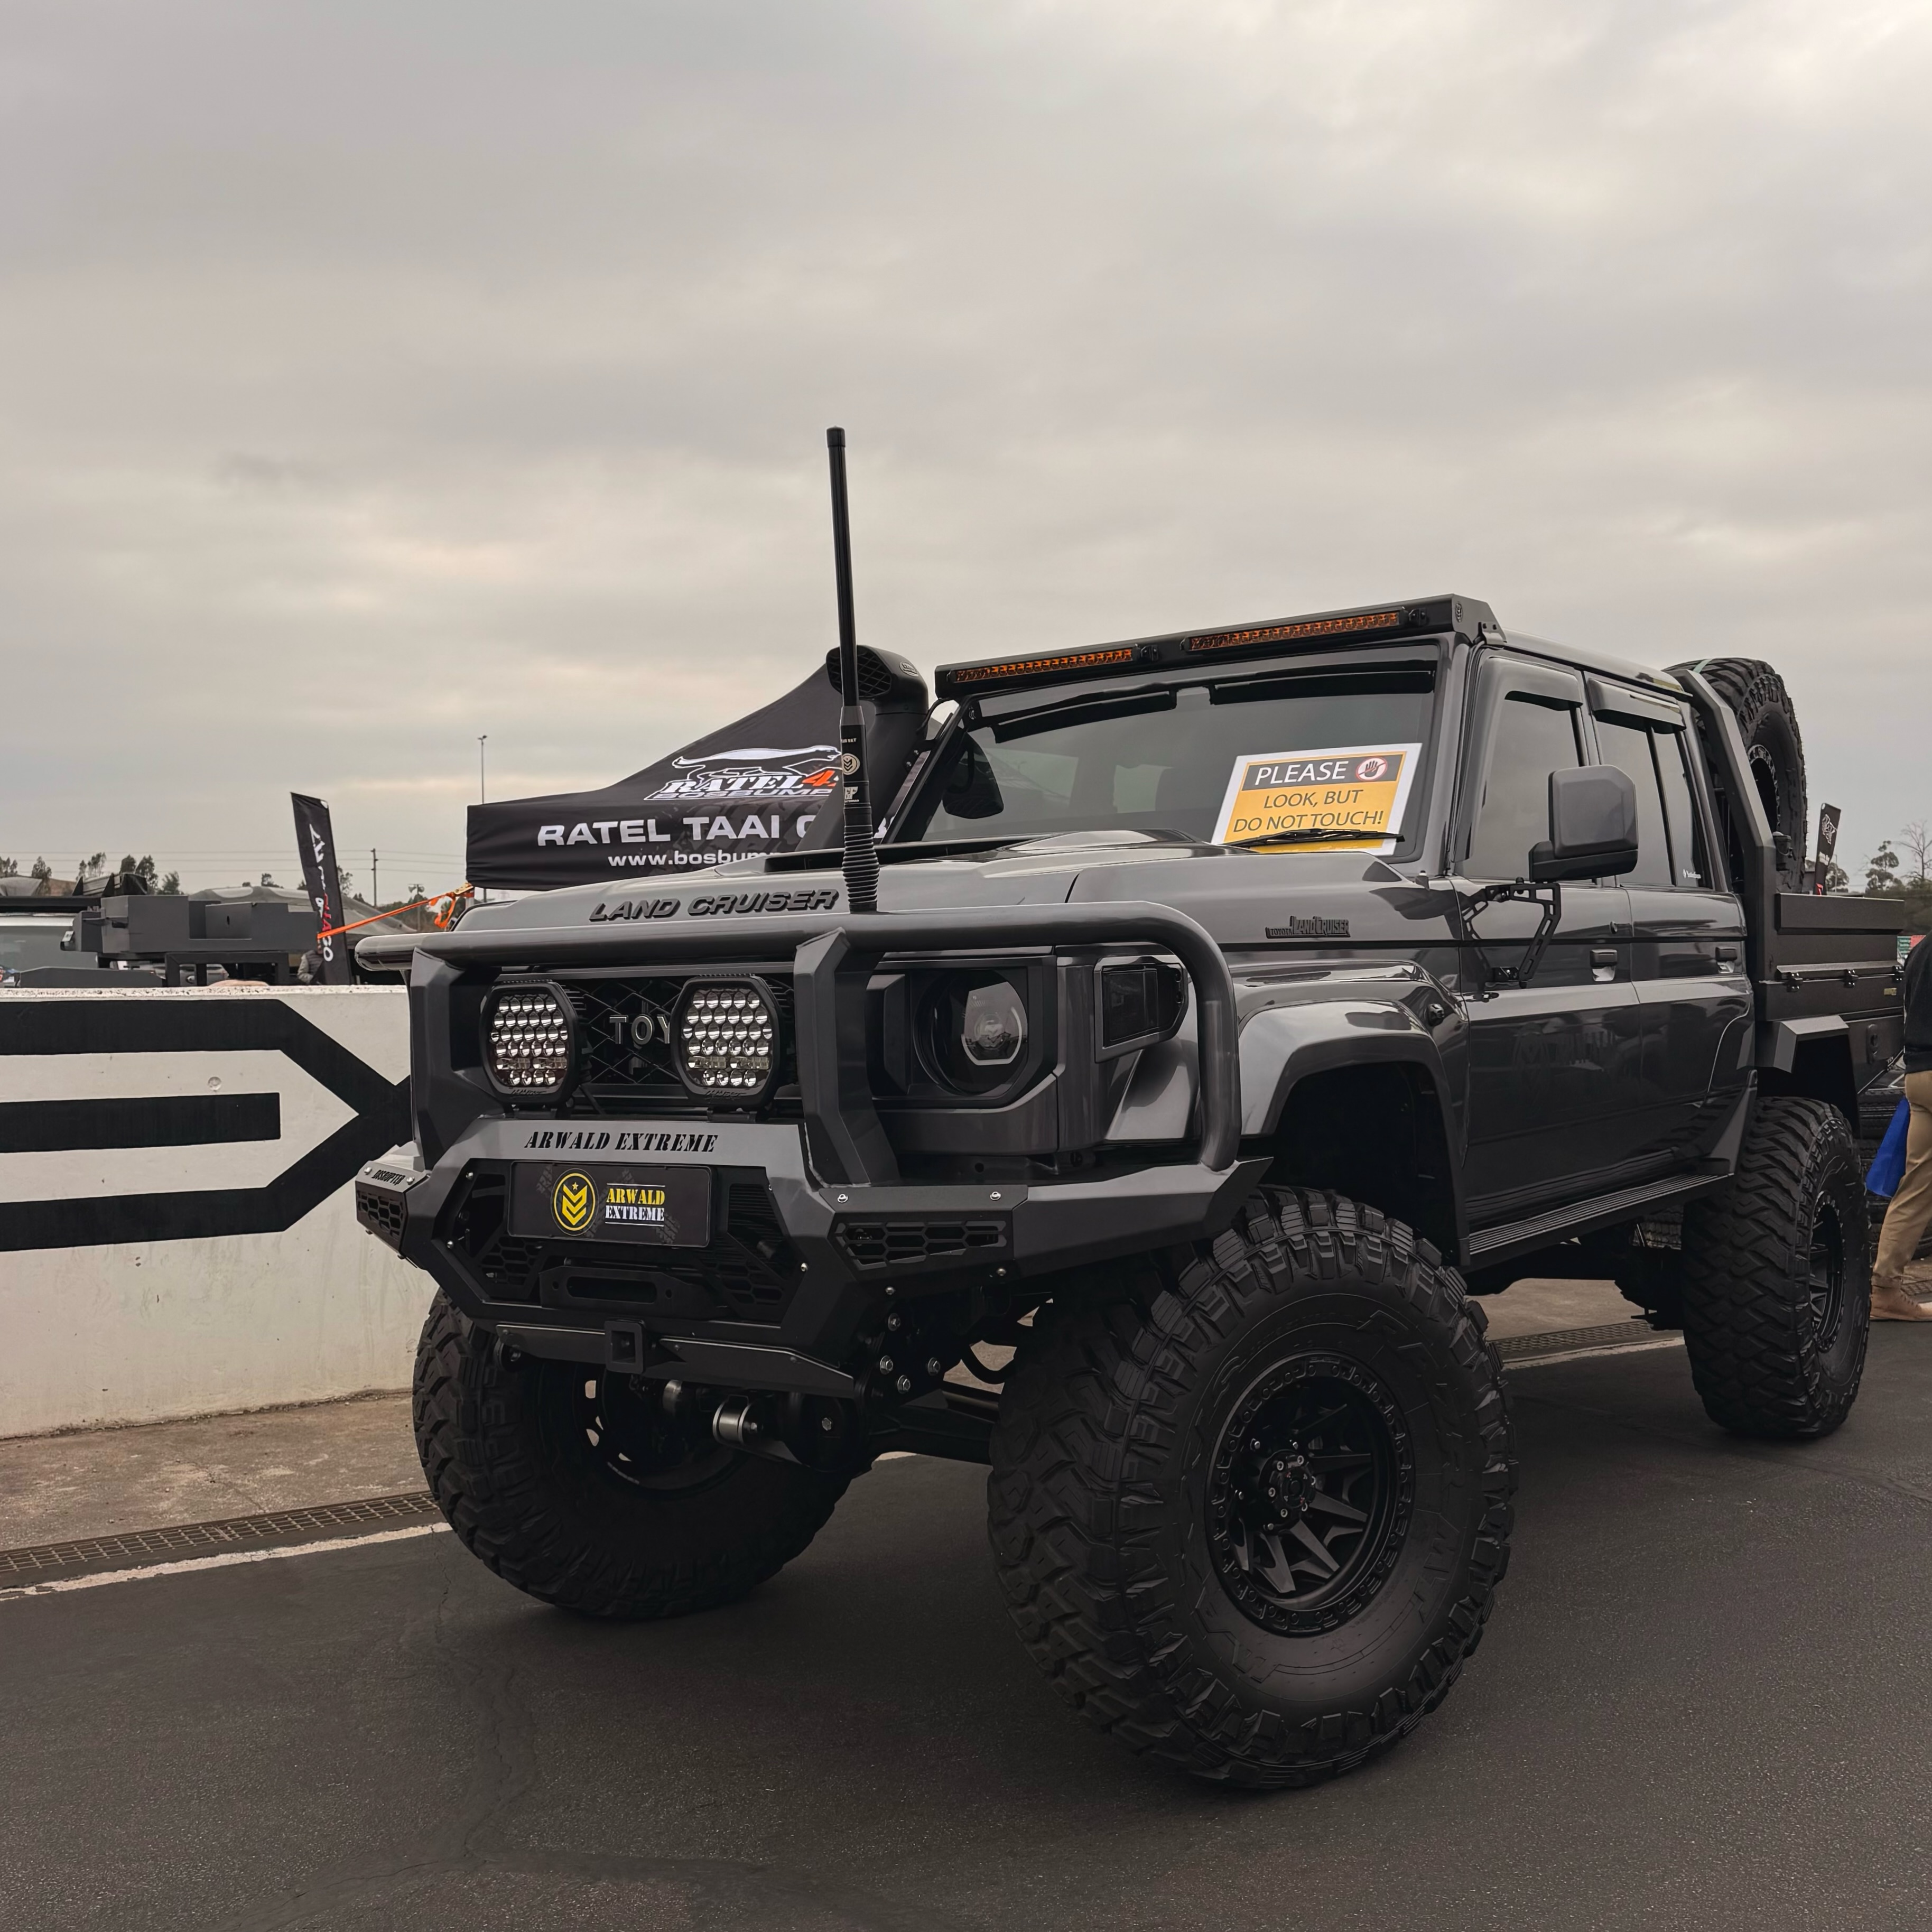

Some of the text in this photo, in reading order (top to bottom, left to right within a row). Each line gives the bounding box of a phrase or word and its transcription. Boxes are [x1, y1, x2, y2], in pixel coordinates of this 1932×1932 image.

[1255, 761, 1349, 785] PLEASE
[653, 788, 833, 799] BOSBUMP
[660, 775, 804, 793] RATEL
[1264, 789, 1363, 809] LOOK, BUT
[537, 819, 671, 847] RATEL
[683, 815, 779, 840] TAAI
[1233, 810, 1384, 832] DO NOT TOUCH!
[608, 849, 779, 867] www.bosbu
[589, 889, 839, 922] LAND CRUISER
[609, 1015, 670, 1045] TOY
[524, 1131, 719, 1153] ARWALD EXTREME
[606, 1188, 665, 1205] ARWALD
[605, 1205, 665, 1221] EXTREME
